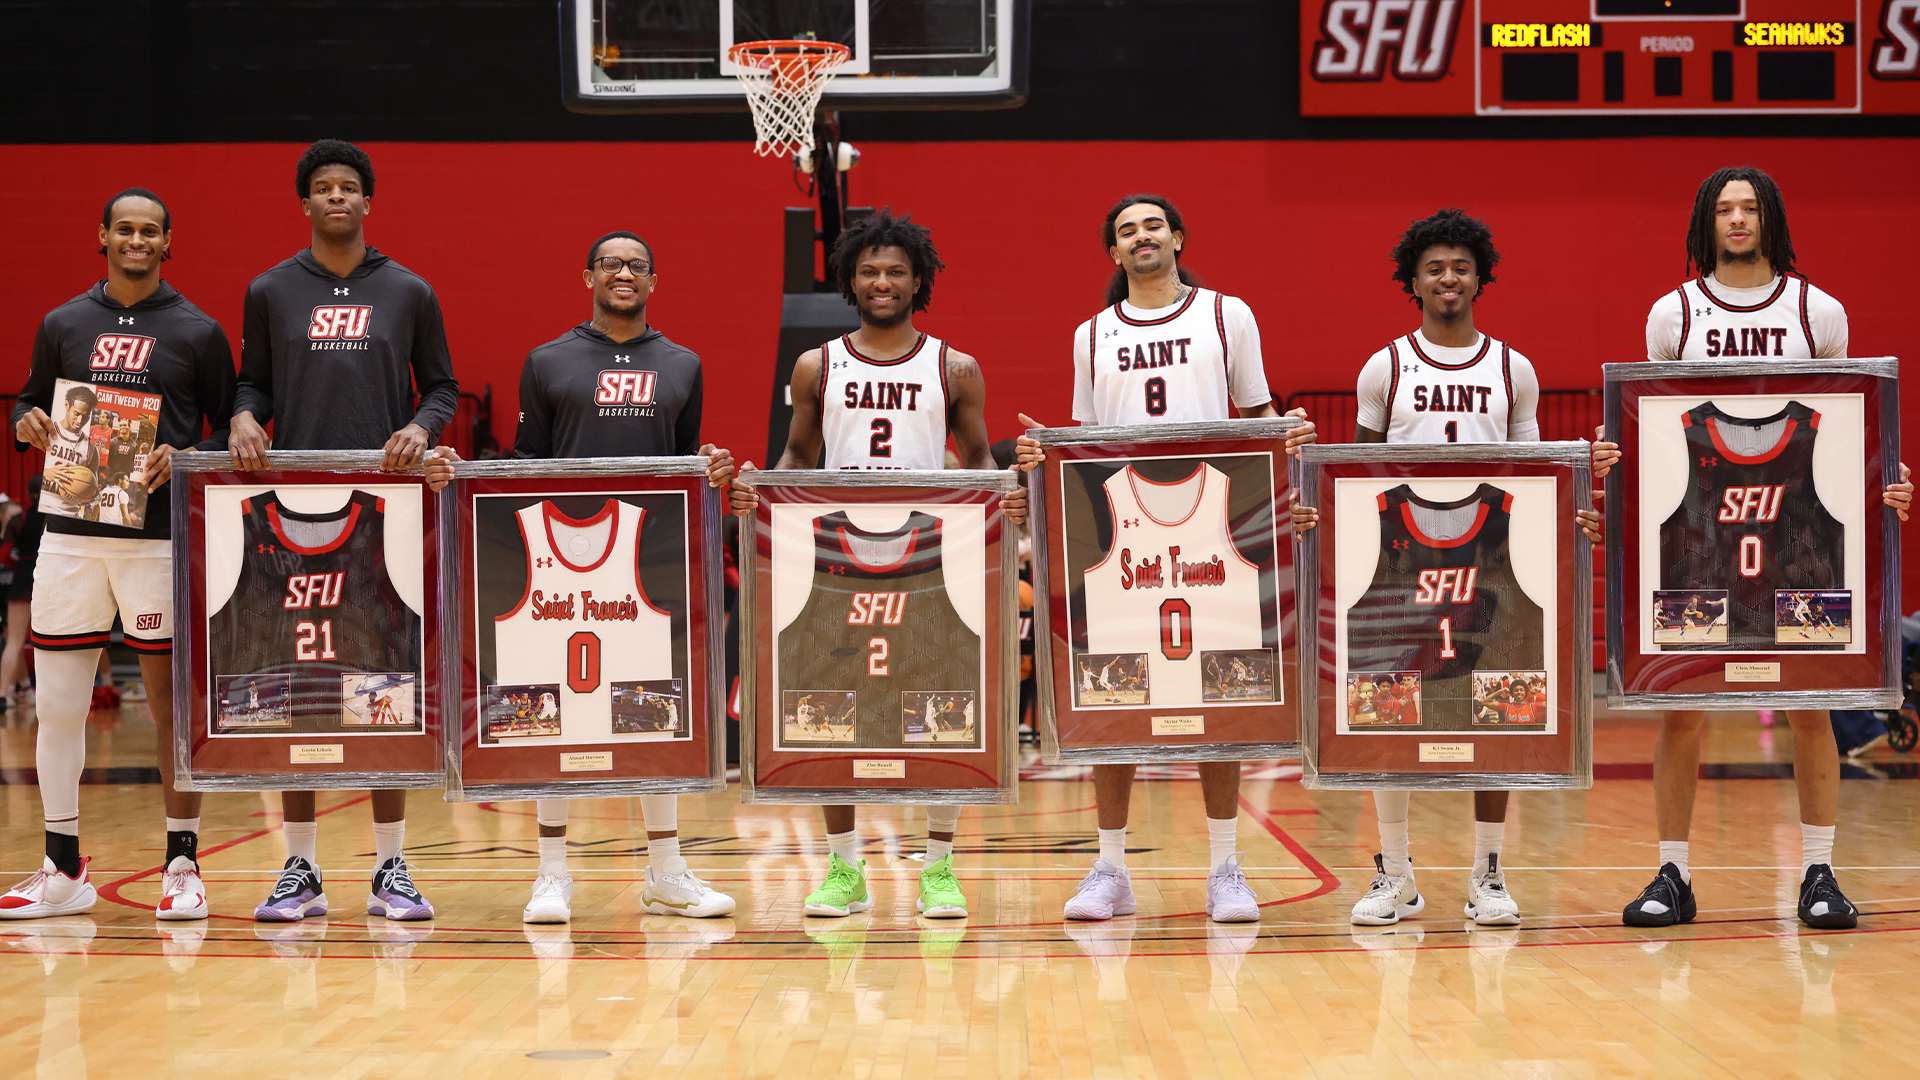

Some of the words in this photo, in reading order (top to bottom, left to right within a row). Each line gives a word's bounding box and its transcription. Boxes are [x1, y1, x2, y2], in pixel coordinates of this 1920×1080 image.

[1313, 0, 1461, 80] SFU
[1491, 24, 1591, 47] REDFLASH
[1640, 36, 1694, 53] PERIOD
[1744, 22, 1845, 46] SEAHAWKS
[593, 84, 636, 93] SPALDING
[308, 305, 373, 340] SFU
[90, 333, 156, 373] SFU
[311, 341, 368, 351] BASKETBALL
[1117, 337, 1191, 372] SAINT
[1706, 327, 1787, 358] SAINT
[91, 373, 147, 384] BASKETBALL
[594, 369, 658, 406] SFU
[845, 381, 922, 411] SAINT
[97, 391, 112, 404] CAM
[114, 394, 141, 408] TWEEDY
[142, 396, 161, 411] #20
[598, 408, 655, 417] BASKETBALL
[1144, 376, 1167, 417] 8
[1414, 384, 1492, 414] SAINT
[50, 444, 82, 465] SAINT
[869, 417, 892, 458] 2
[101, 492, 115, 508] 20
[1717, 484, 1786, 524] SFU
[1120, 547, 1164, 590] Saint
[1169, 545, 1226, 588] Francis
[1739, 534, 1763, 578] 0
[283, 571, 346, 610] SFU
[1414, 566, 1479, 605] SFU
[136, 613, 162, 630] SFU
[531, 589, 575, 621] Saint
[581, 590, 638, 621] Francis
[847, 591, 909, 626] SFU
[295, 619, 337, 662] 21
[1159, 598, 1193, 661] 0
[1437, 616, 1456, 659] 1
[567, 631, 601, 693] 0
[867, 636, 890, 677] 2
